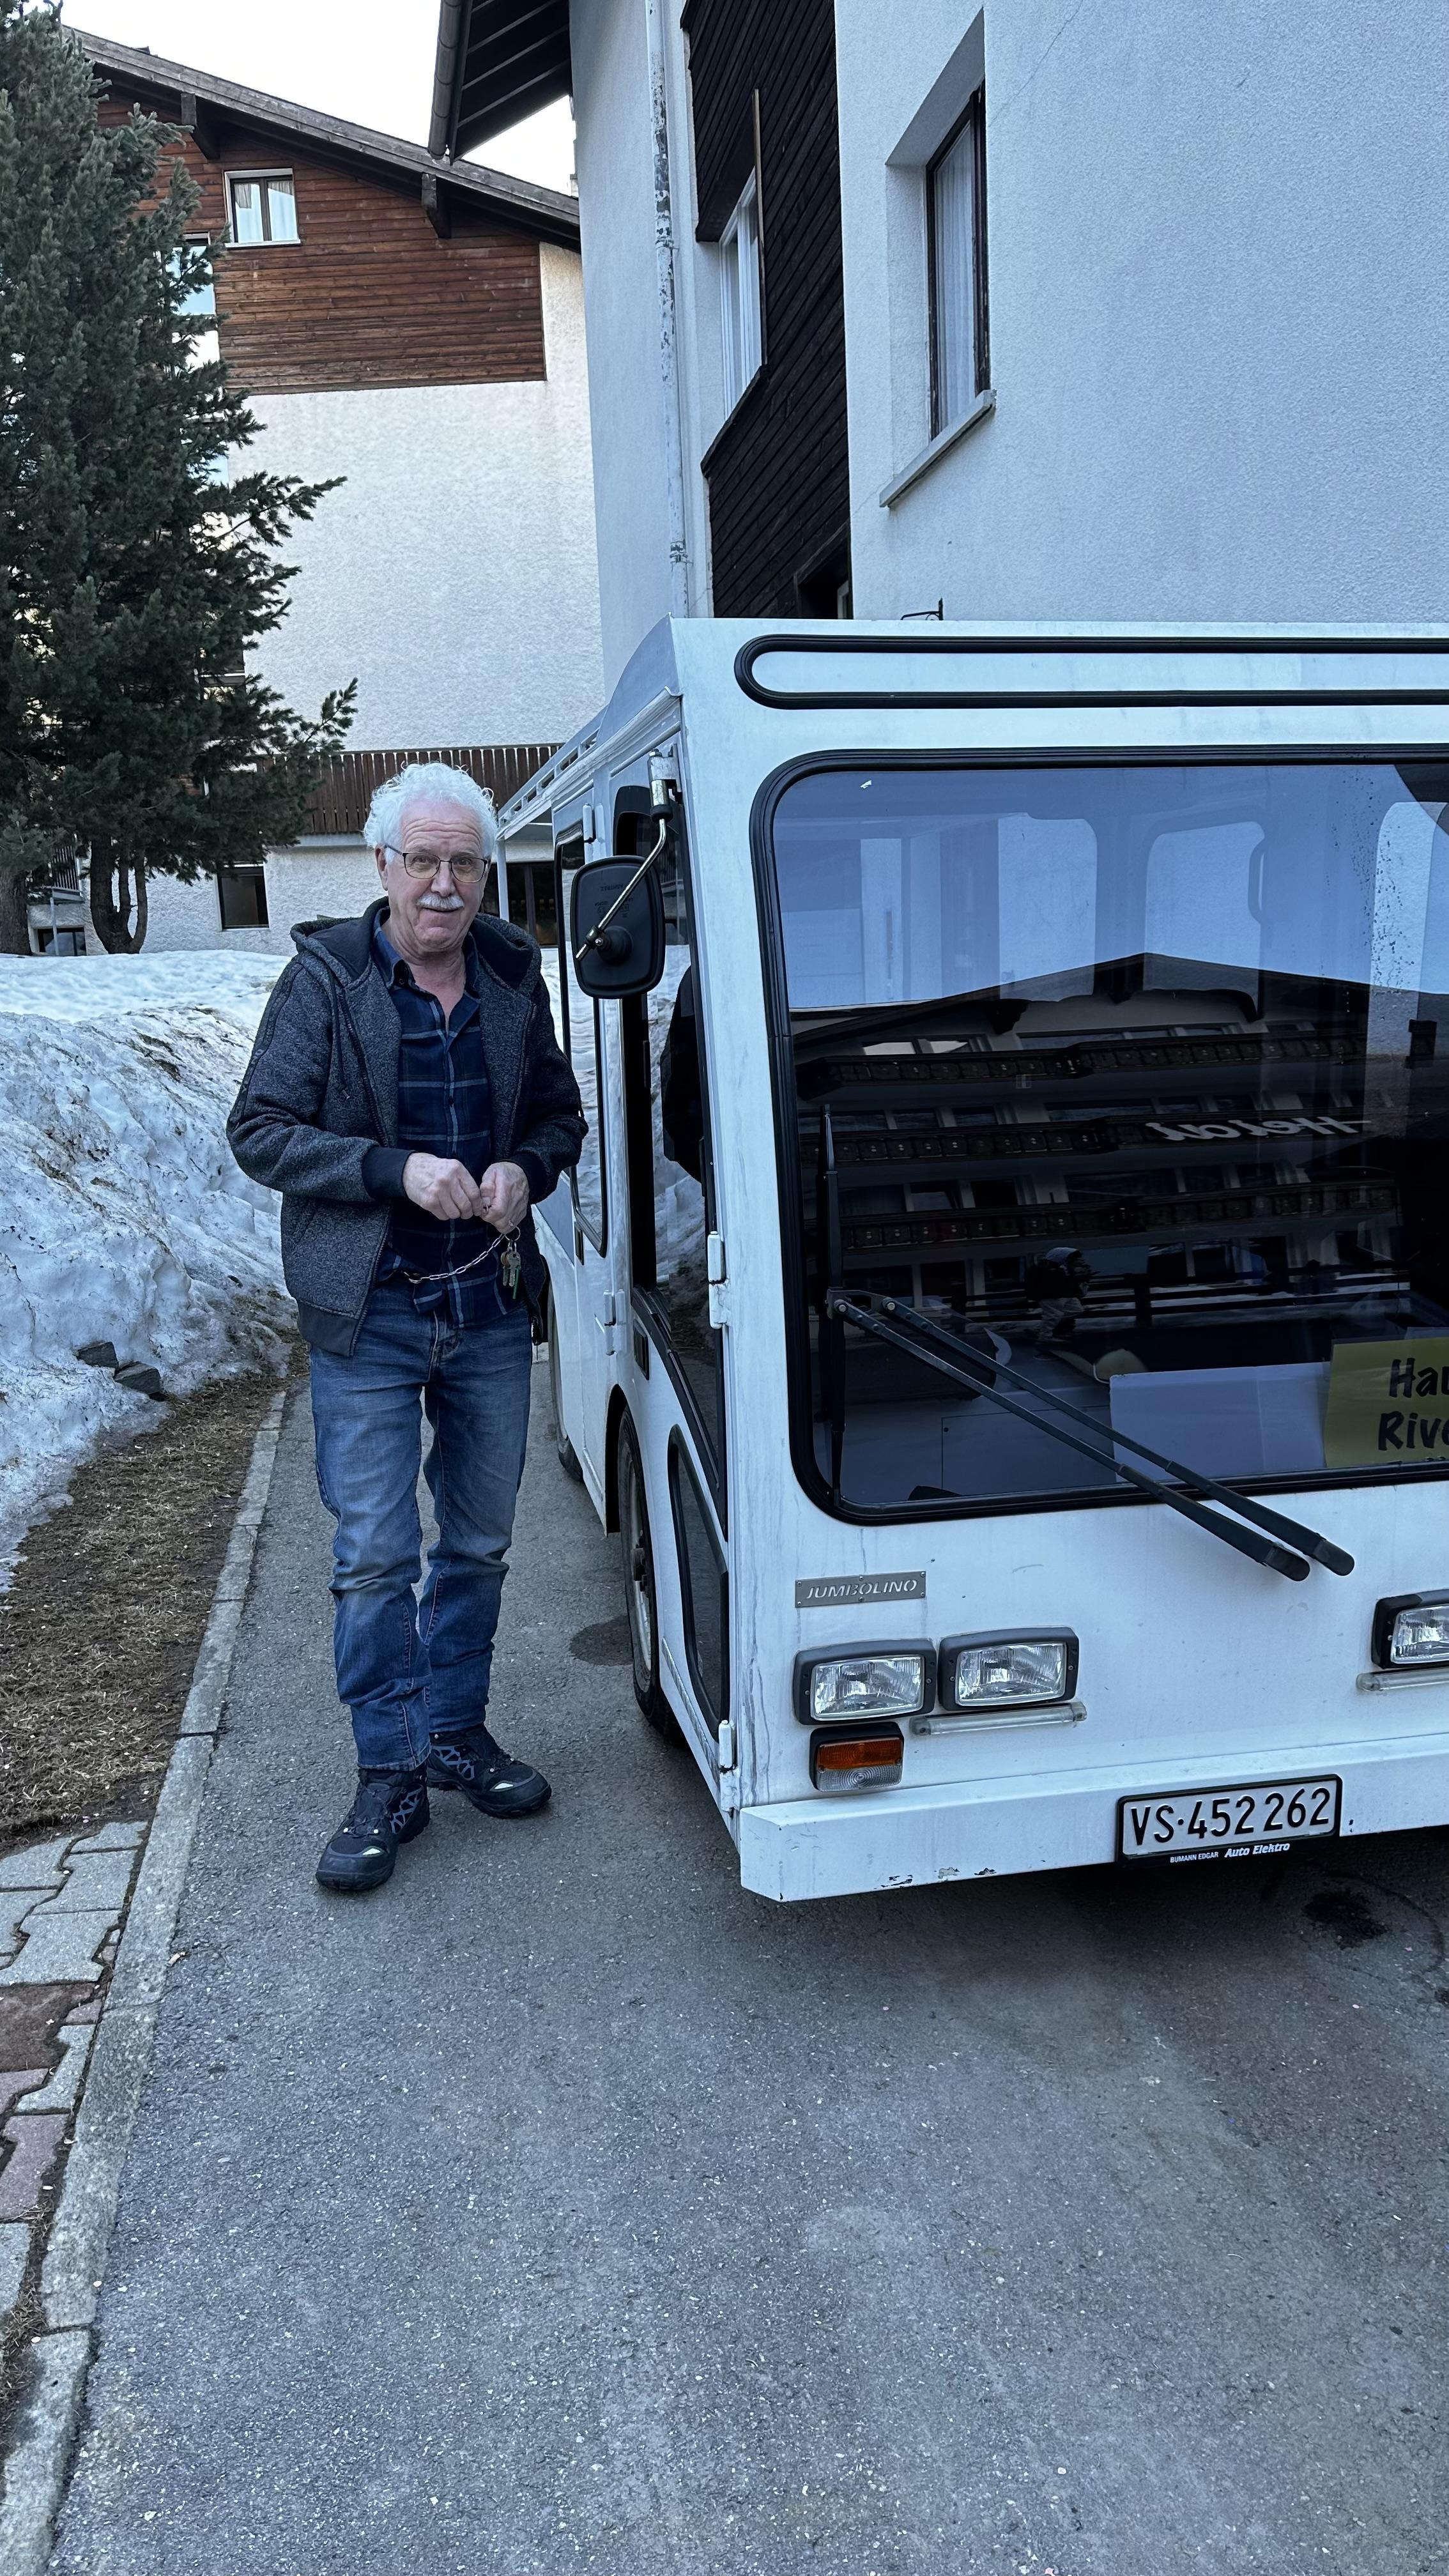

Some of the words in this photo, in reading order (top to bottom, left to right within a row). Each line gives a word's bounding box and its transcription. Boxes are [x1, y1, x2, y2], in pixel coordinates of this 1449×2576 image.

[806, 1579, 917, 1599] JUMBOLINO
[1198, 1851, 1219, 1860] EDGAR
[1223, 1847, 1250, 1858] Auto
[1252, 1843, 1291, 1855] Elektro
